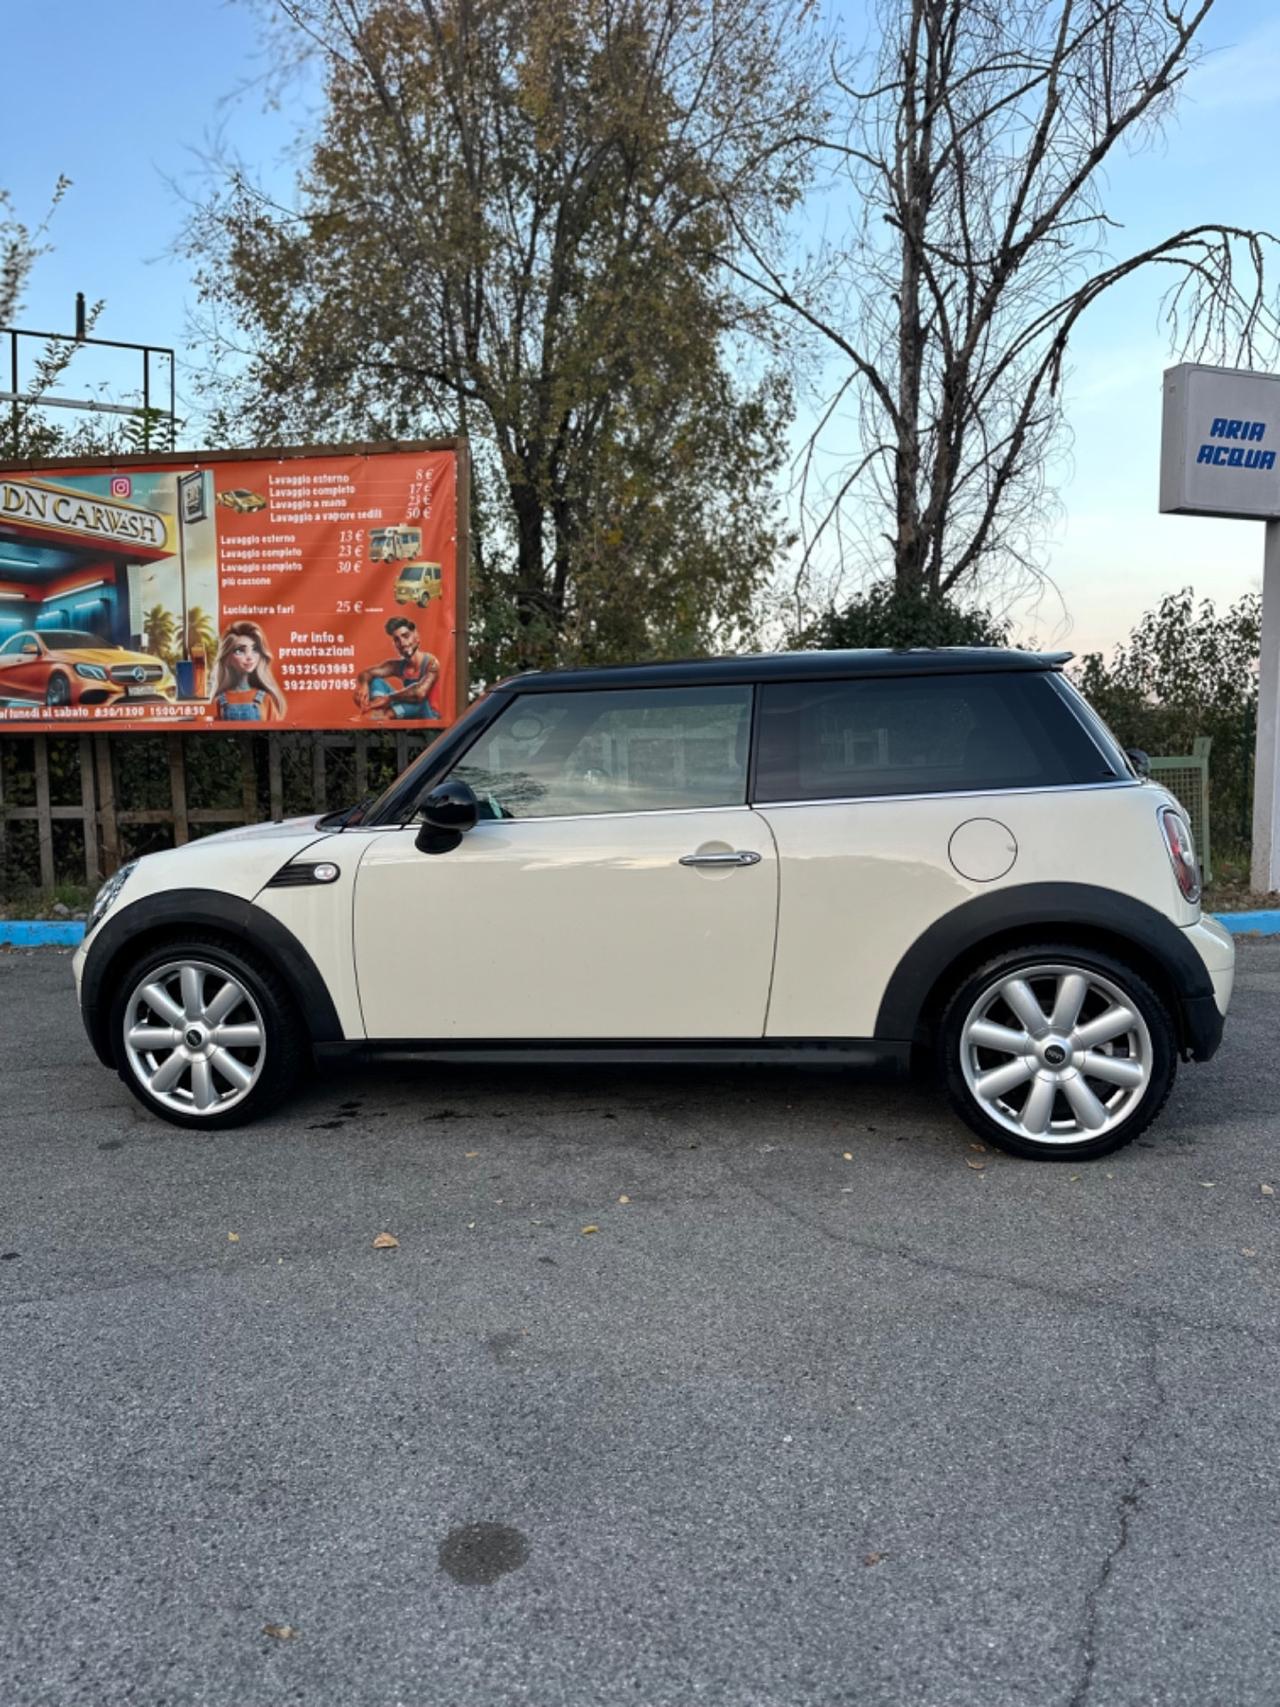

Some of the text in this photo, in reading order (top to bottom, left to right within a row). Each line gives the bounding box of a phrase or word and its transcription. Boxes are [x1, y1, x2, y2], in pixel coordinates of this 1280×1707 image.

[1210, 418, 1266, 442] ARIA
[1196, 444, 1276, 470] ACQUA
[268, 468, 434, 486] Lavaggio esterno 8 €
[269, 486, 311, 498] Lavaggio
[312, 485, 356, 497] completo
[423, 481, 432, 493] €
[2, 485, 48, 519] DN
[269, 499, 312, 511] Lavaggio
[321, 499, 347, 508] mano
[422, 494, 432, 506] €
[270, 512, 313, 524] Lavaggio
[314, 513, 321, 521] a
[322, 511, 355, 522] vapore
[422, 506, 432, 519] €
[220, 529, 365, 546] Lavaggio esterno 13 €
[221, 549, 260, 559] Lavaggio
[262, 548, 303, 559] completo
[354, 545, 364, 557] €
[221, 560, 363, 574] Lavaggio completo 30 €
[237, 576, 271, 586] cassone
[223, 604, 275, 615] Lucidatura
[277, 604, 295, 614] fari
[336, 600, 351, 613] 25
[353, 600, 364, 613] €
[290, 631, 309, 643] Per
[337, 633, 344, 643] e
[279, 645, 355, 660] prenotazioni
[53, 706, 89, 718] sabato
